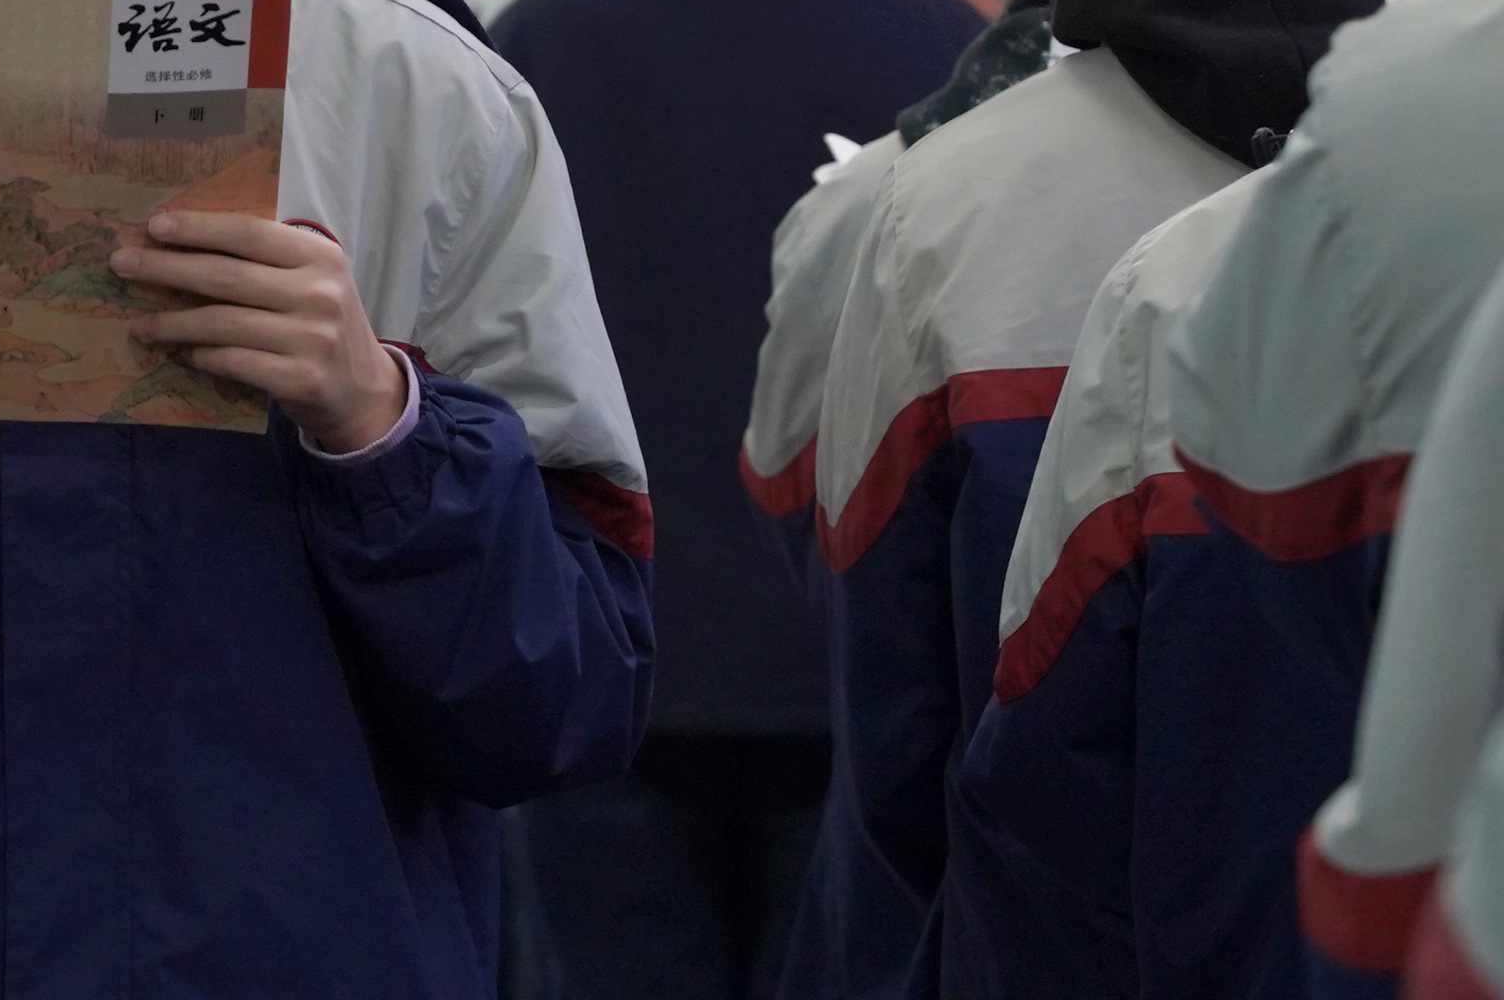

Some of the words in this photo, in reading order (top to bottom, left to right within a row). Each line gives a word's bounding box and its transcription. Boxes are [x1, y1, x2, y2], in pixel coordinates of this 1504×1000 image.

[117, 1, 246, 53] 语文
[145, 68, 212, 82] 选择性必修
